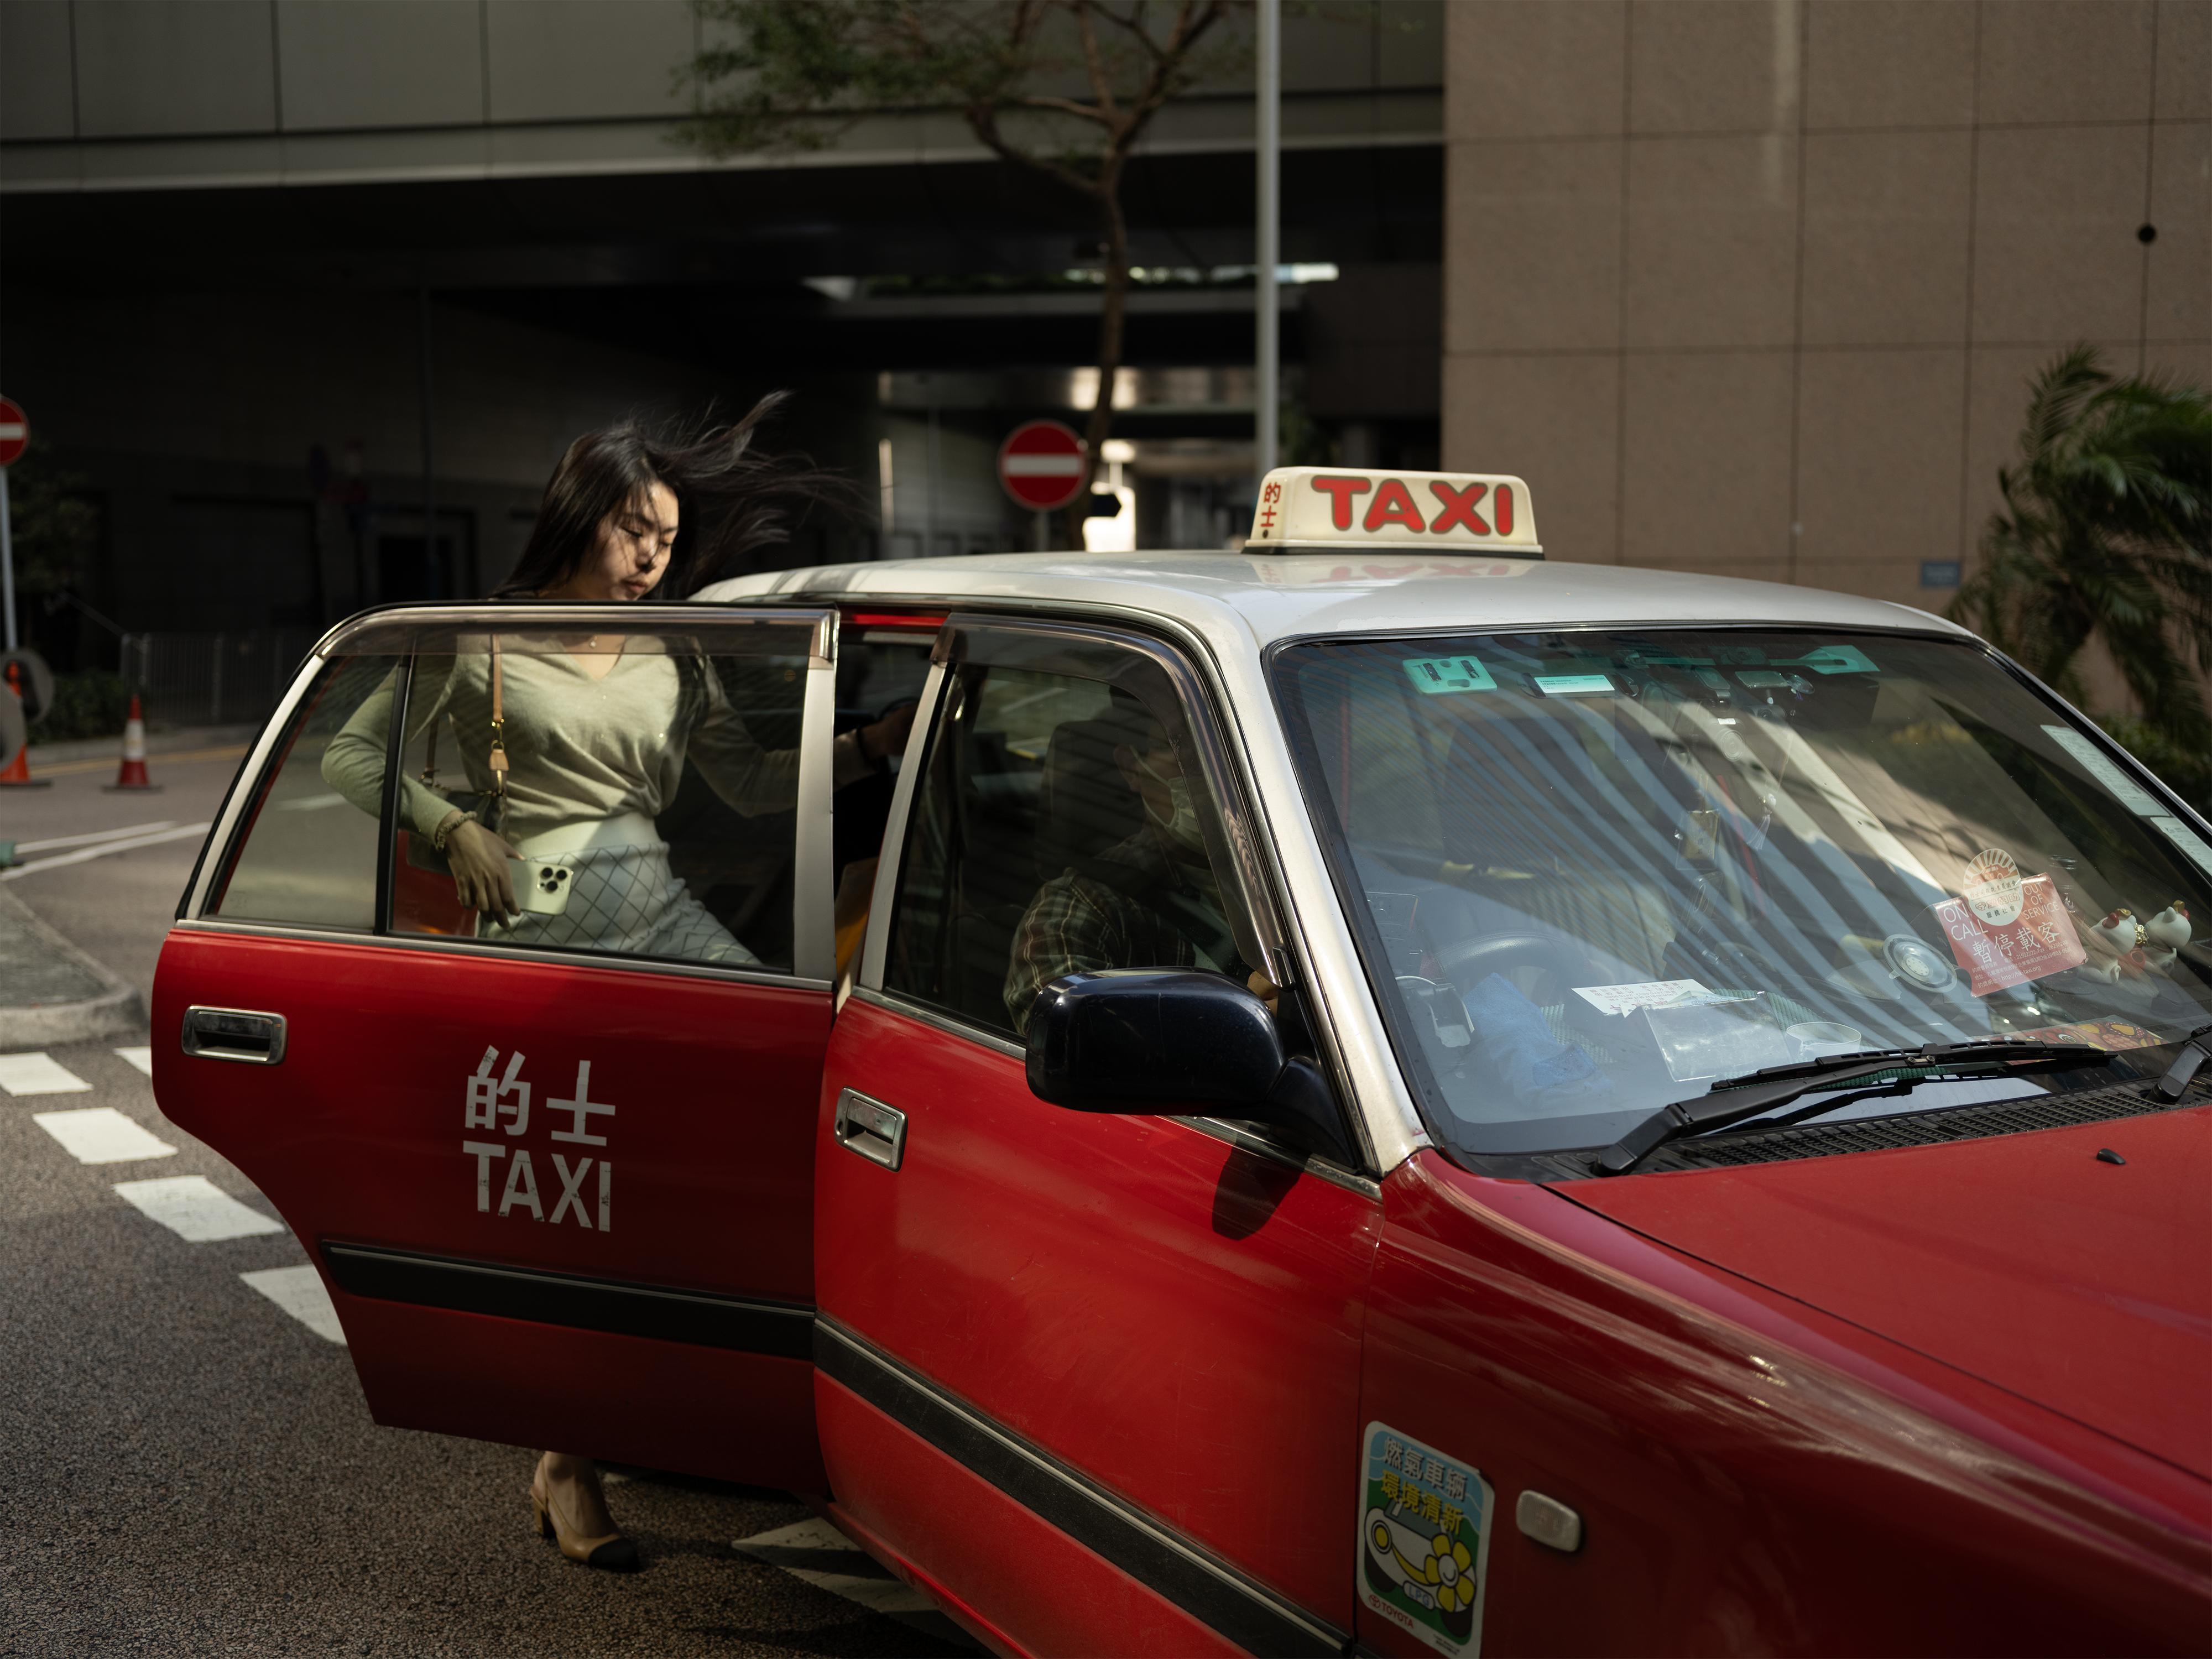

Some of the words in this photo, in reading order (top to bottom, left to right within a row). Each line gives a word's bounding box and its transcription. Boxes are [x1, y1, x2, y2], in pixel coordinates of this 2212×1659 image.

[1260, 481, 1281, 528] 的士
[1311, 474, 1514, 536] TAXI
[2024, 882, 2043, 896] OUT
[2031, 894, 2043, 905] OF
[1943, 903, 1969, 923] ON
[1975, 893, 2020, 911] 守望相助
[1986, 905, 2015, 919] 服務社會
[2023, 901, 2060, 920] SERVICE
[1950, 919, 1989, 941] CALL
[1972, 921, 2060, 964] 暫停載客
[465, 1044, 616, 1147] 的士
[463, 1140, 611, 1233] TAXI
[1383, 1436, 1467, 1501] 燃氣車輛
[1380, 1469, 1463, 1535] 環境清新
[1408, 1584, 1430, 1607] LPG
[1381, 1601, 1414, 1629] TOYOTA
